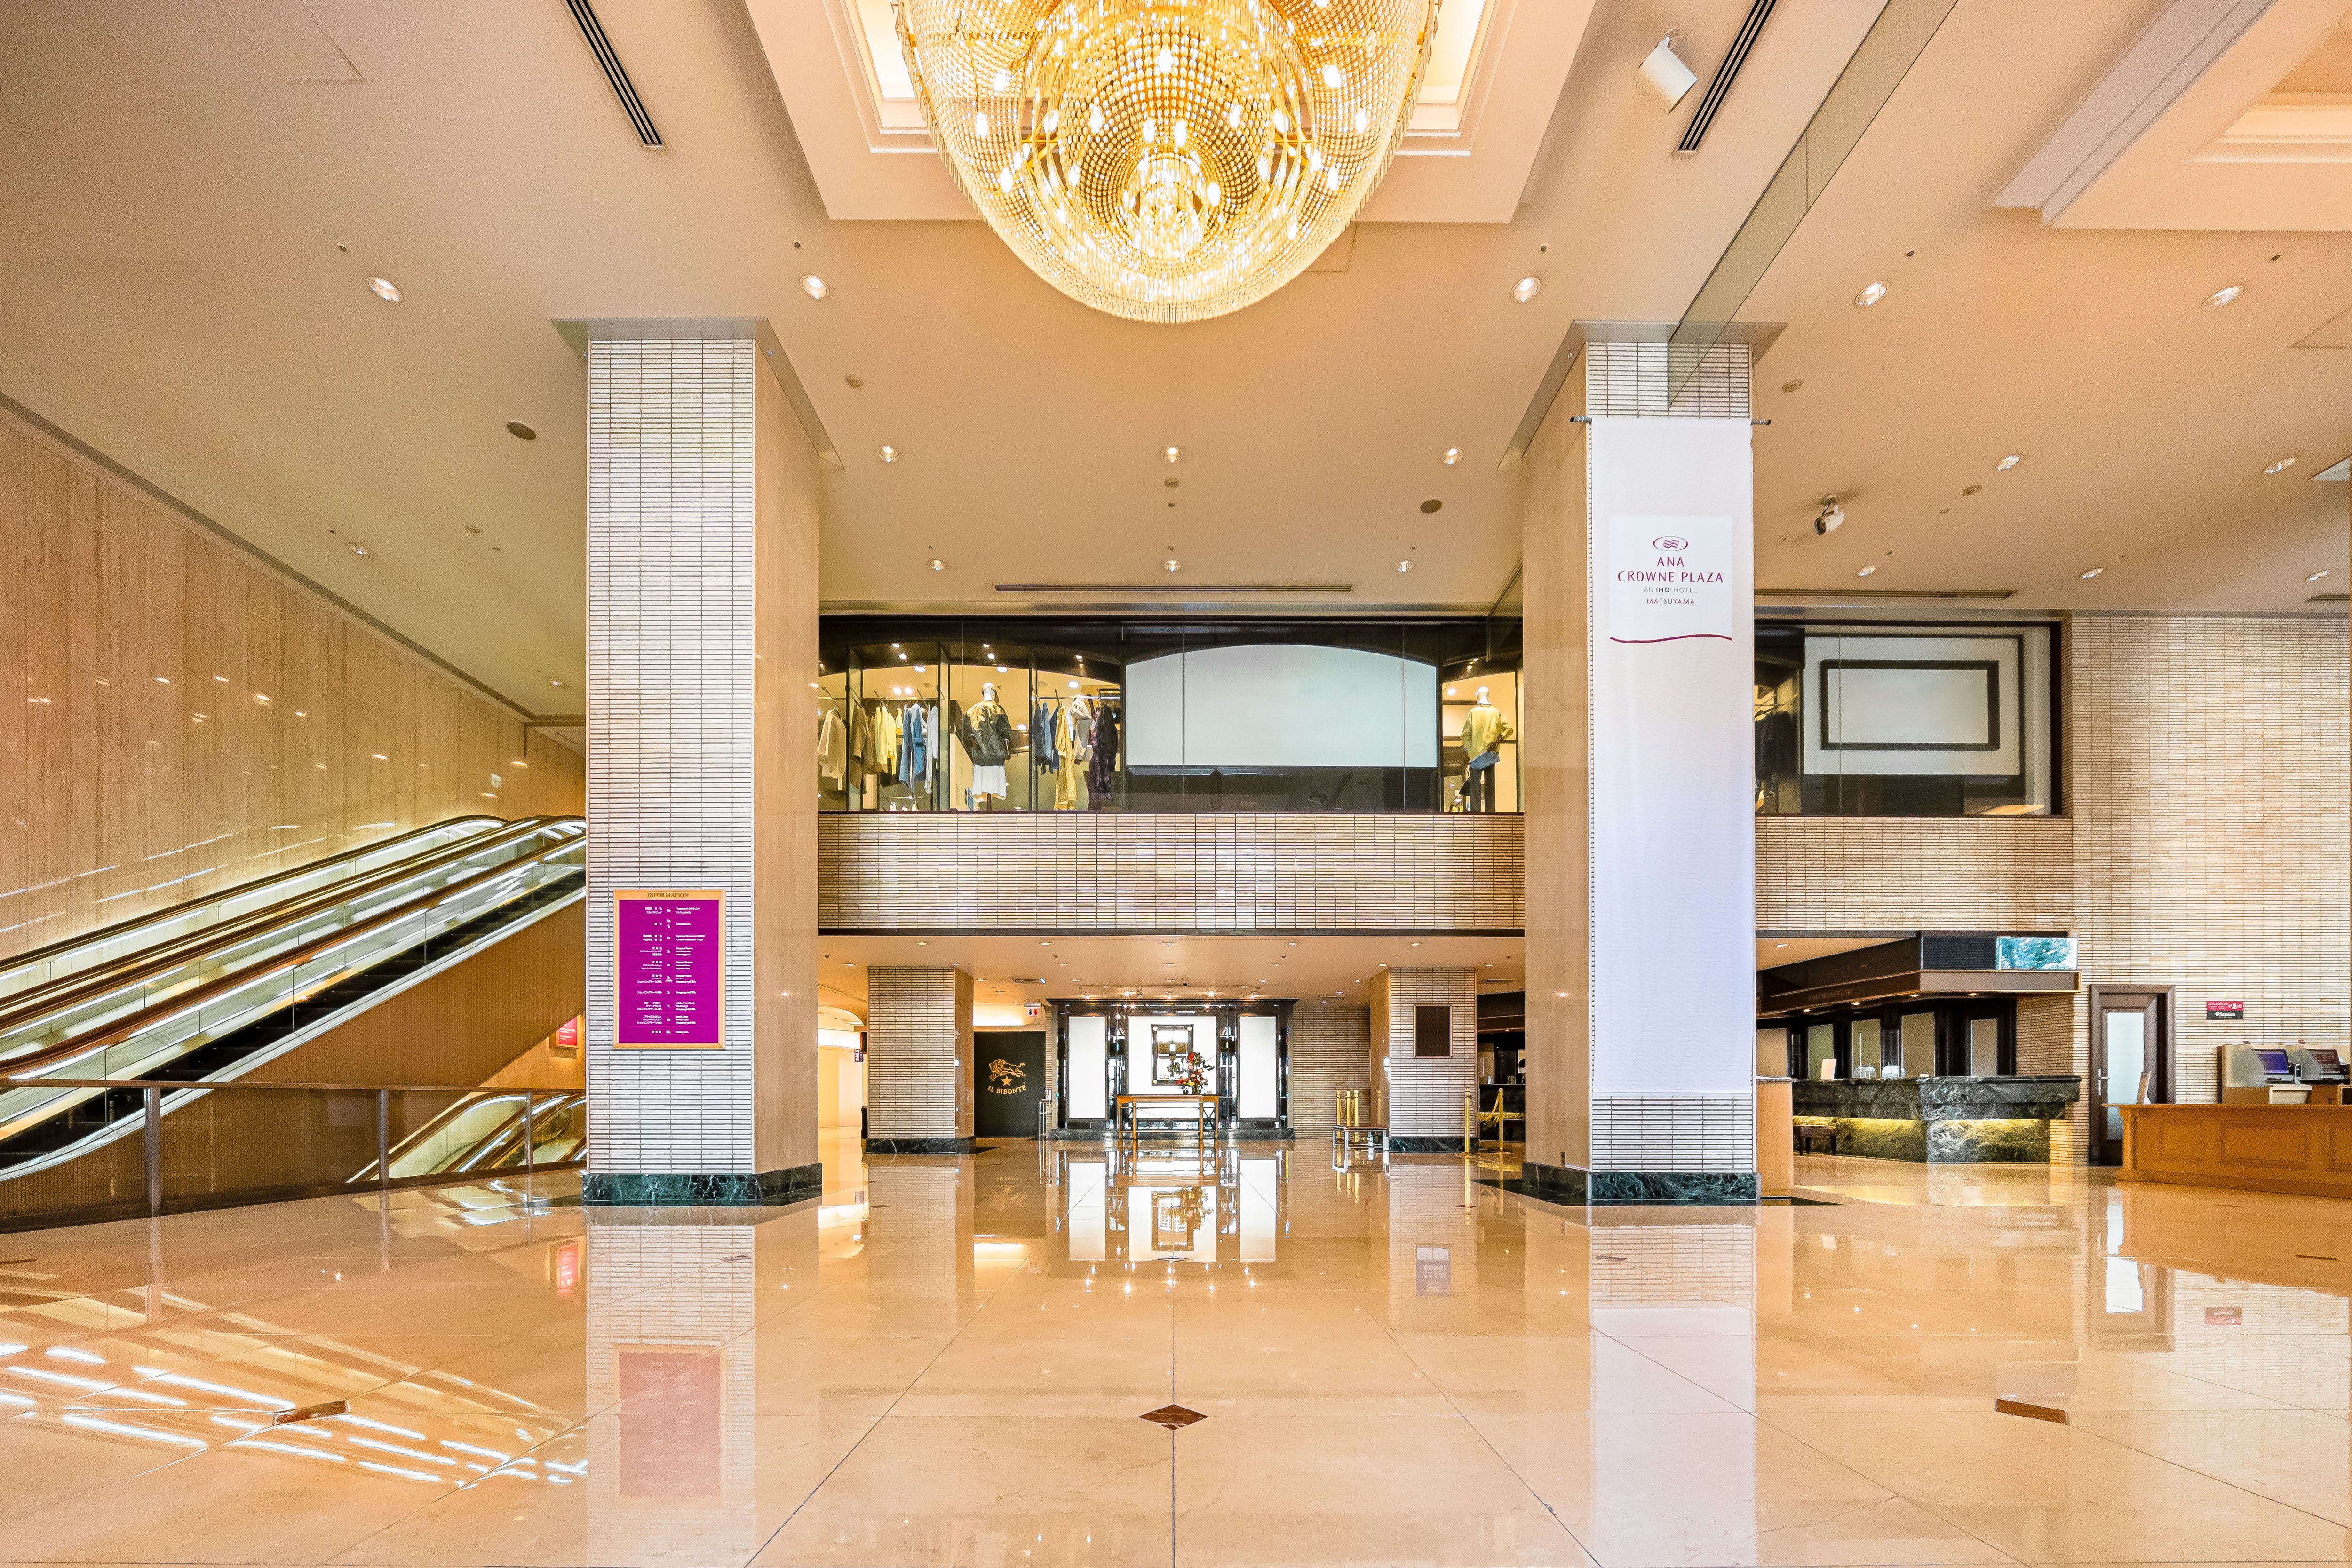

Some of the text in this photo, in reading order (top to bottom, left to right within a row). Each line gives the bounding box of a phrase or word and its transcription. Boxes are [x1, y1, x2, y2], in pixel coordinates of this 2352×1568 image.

[1657, 556, 1685, 567] ANA
[1618, 570, 1724, 583] CROWNE PLAZA
[996, 1085, 1026, 1094] BISONTE
